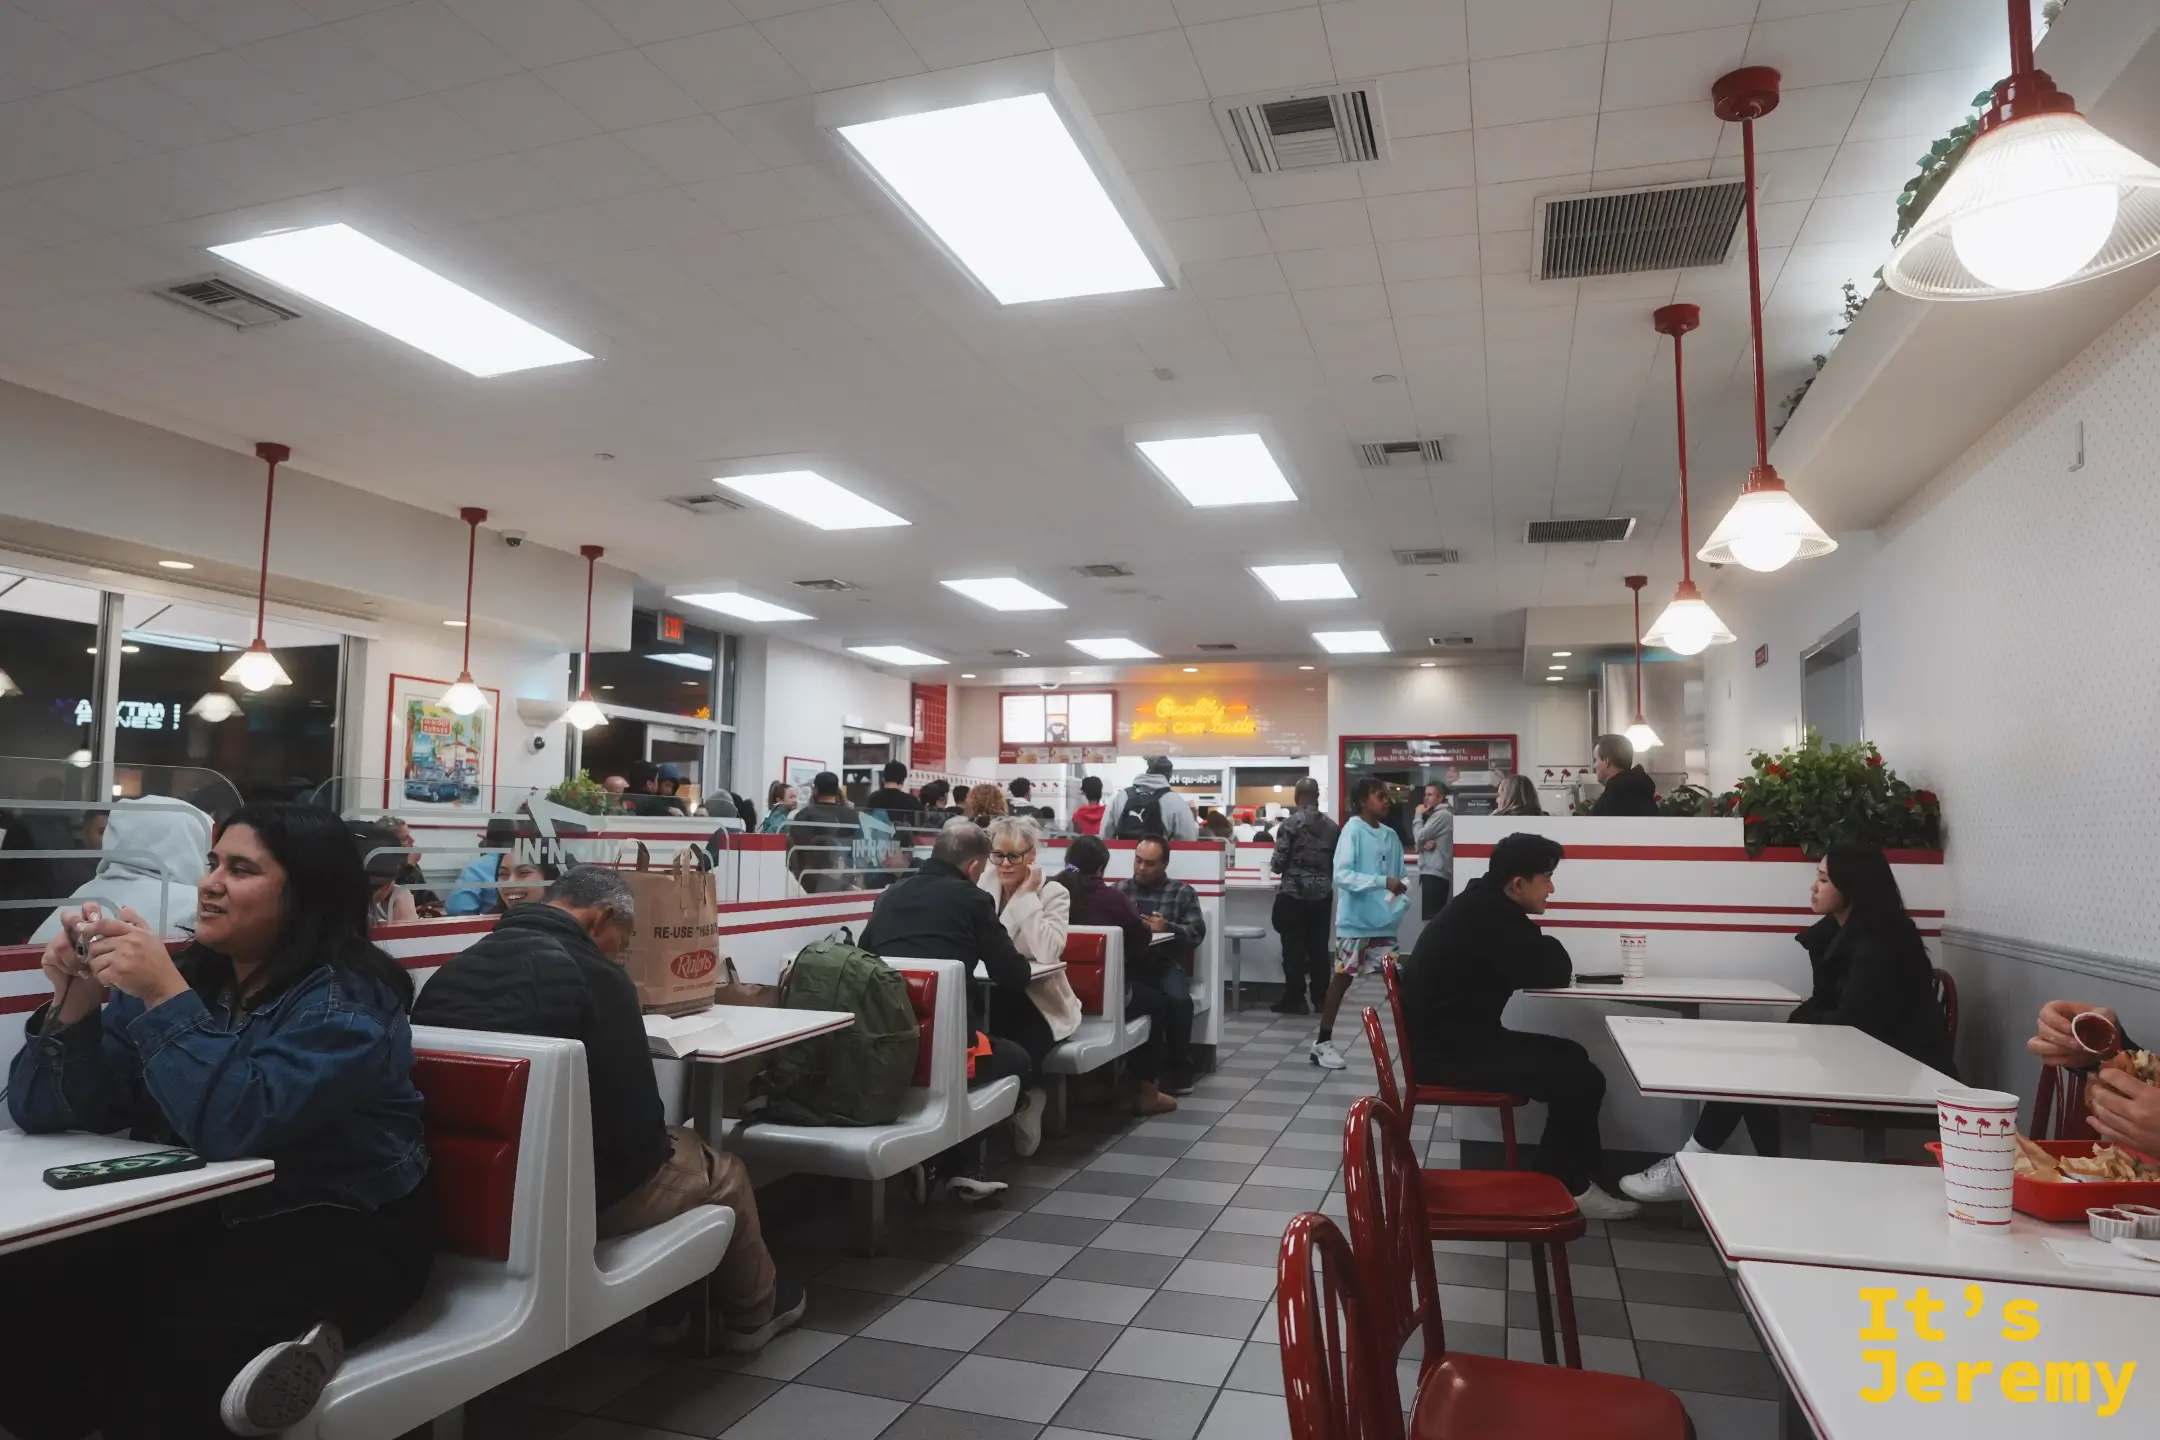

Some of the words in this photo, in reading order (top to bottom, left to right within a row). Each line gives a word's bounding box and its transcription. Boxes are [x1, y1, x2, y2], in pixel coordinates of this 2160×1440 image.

[665, 616, 682, 639] EXIT
[1156, 697, 1226, 726] Quality
[1131, 721, 1168, 740] you
[1172, 721, 1205, 734] can
[1210, 715, 1256, 734] taste
[1349, 747, 1362, 760] A
[653, 926, 693, 939] RE-USE
[676, 952, 713, 978] Ralphs
